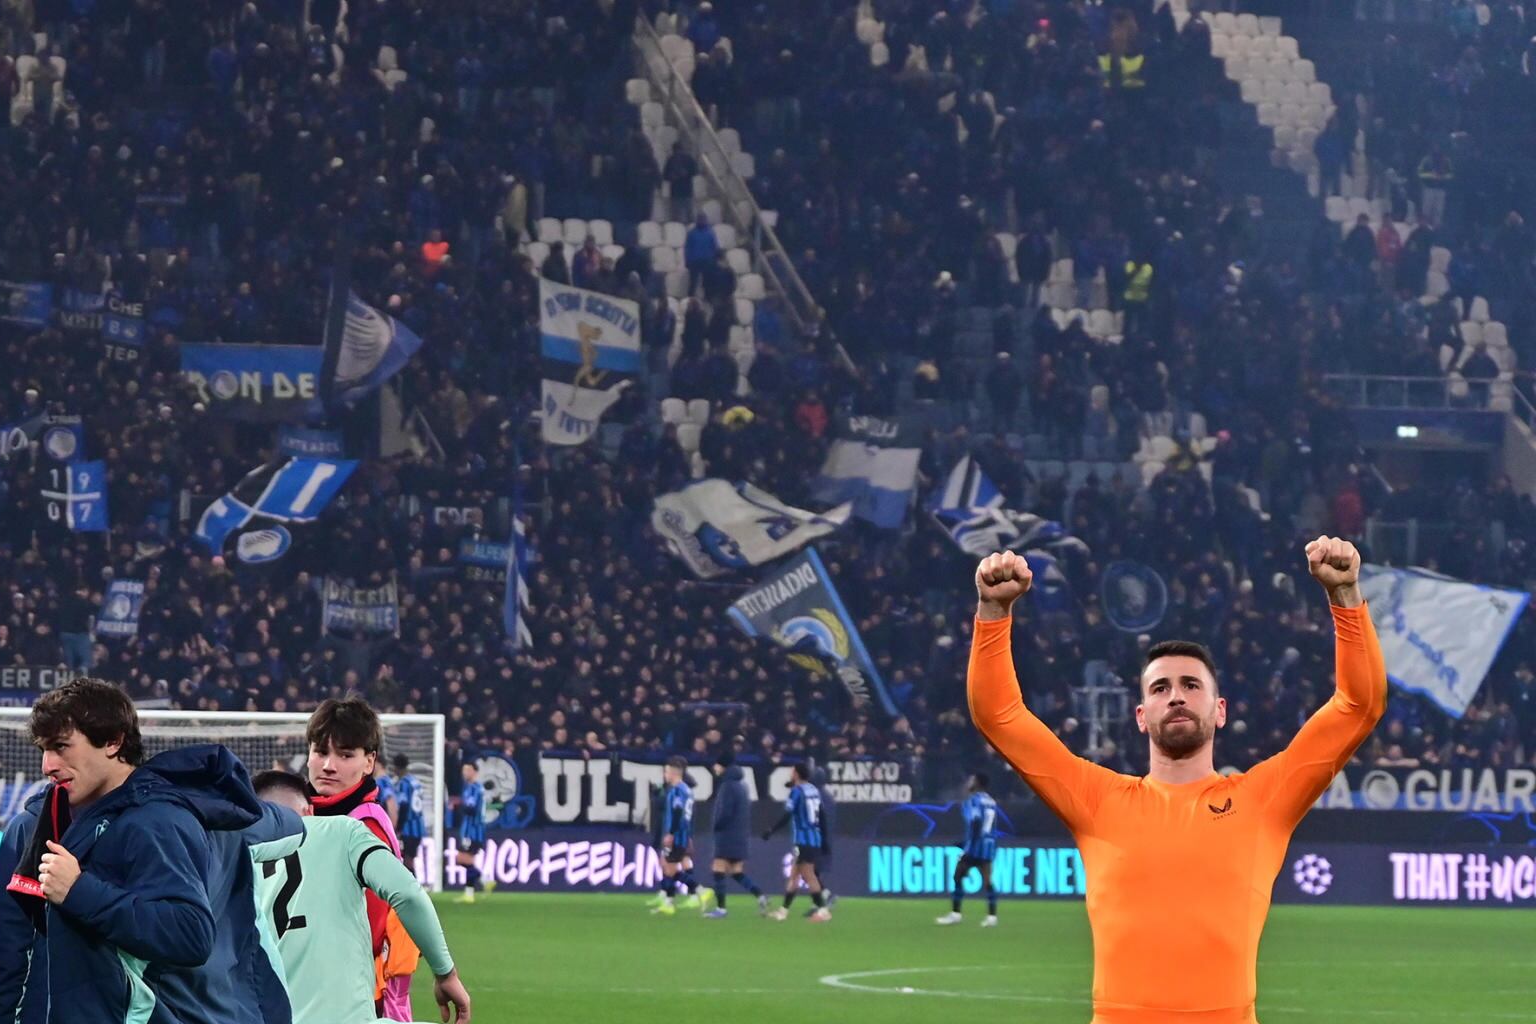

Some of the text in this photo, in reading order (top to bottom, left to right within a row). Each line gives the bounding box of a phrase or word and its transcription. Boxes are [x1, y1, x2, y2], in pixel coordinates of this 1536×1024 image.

[273, 372, 315, 399] DE
[79, 503, 93, 522] 7
[1405, 767, 1536, 812] GUAR
[445, 838, 664, 889] #UCLFEELIN
[1389, 853, 1536, 903] THAT #UC
